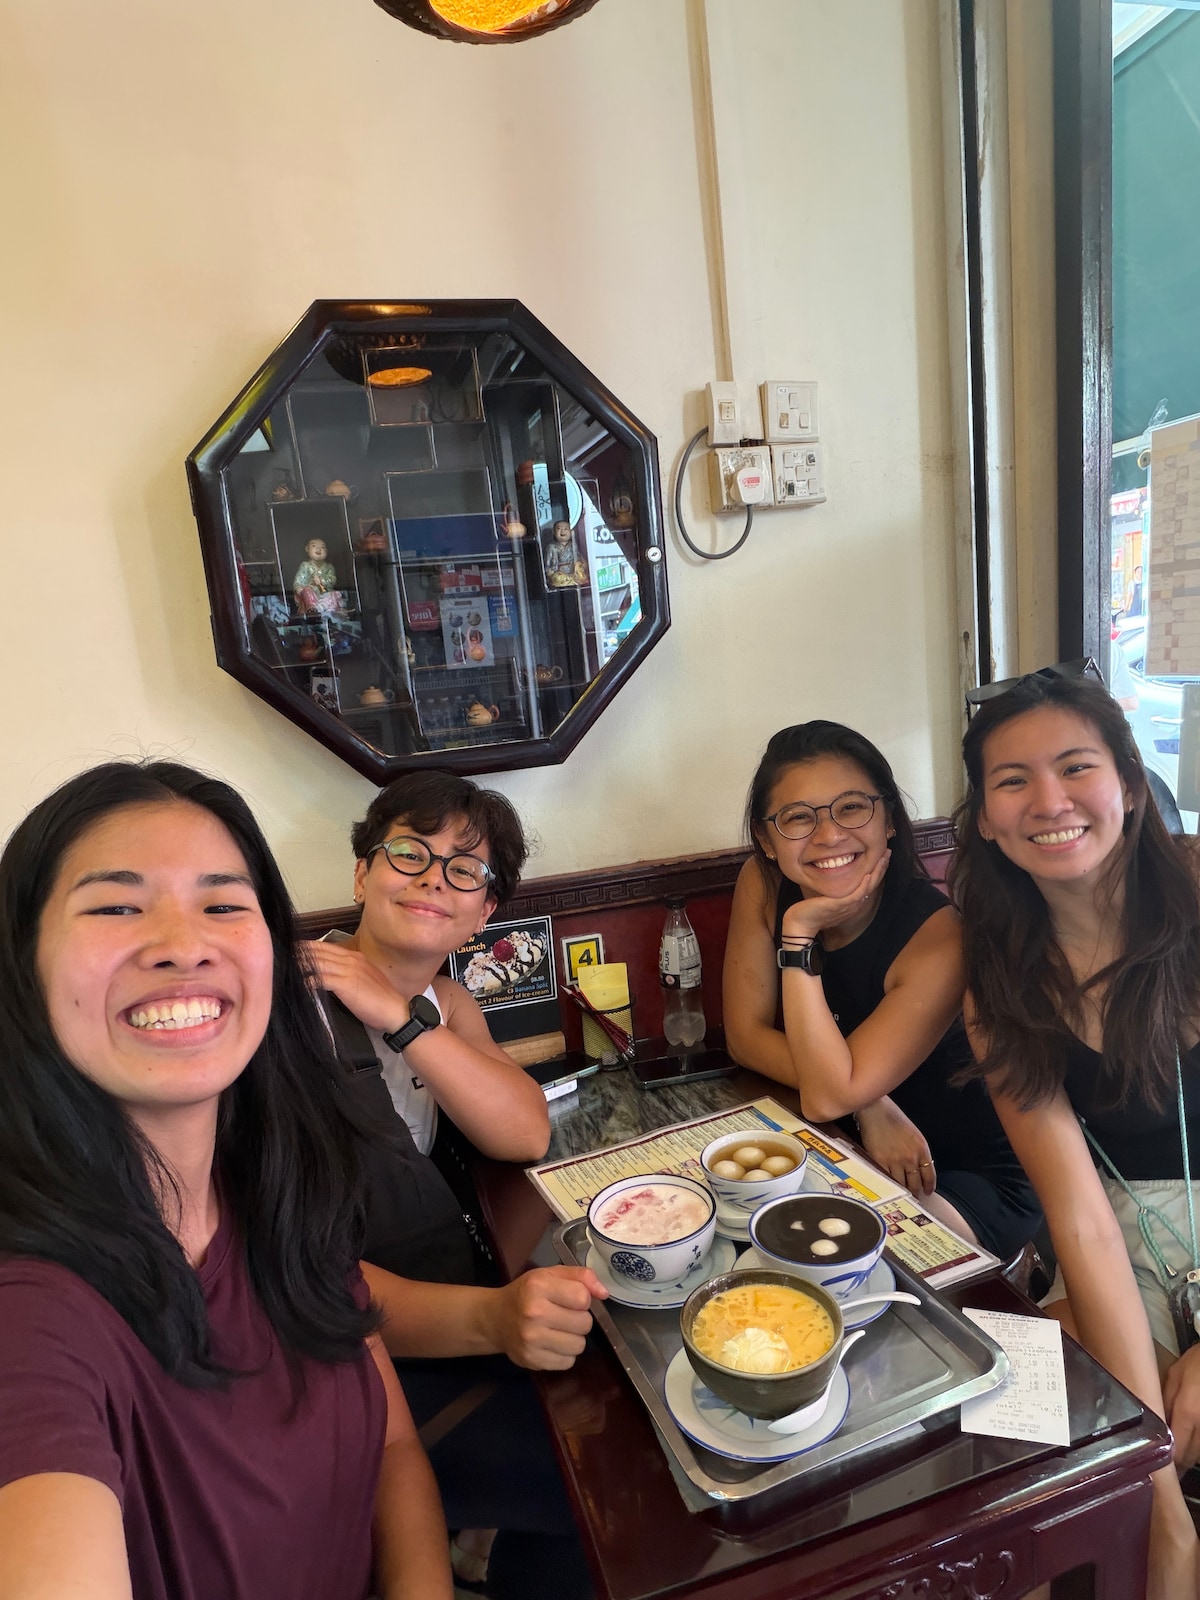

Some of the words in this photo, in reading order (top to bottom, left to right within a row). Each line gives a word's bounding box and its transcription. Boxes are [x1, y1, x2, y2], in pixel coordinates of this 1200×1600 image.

[456, 942, 486, 954] Launch
[579, 948, 593, 965] 4
[514, 985, 535, 993] Banana
[493, 994, 514, 1003] Flavour
